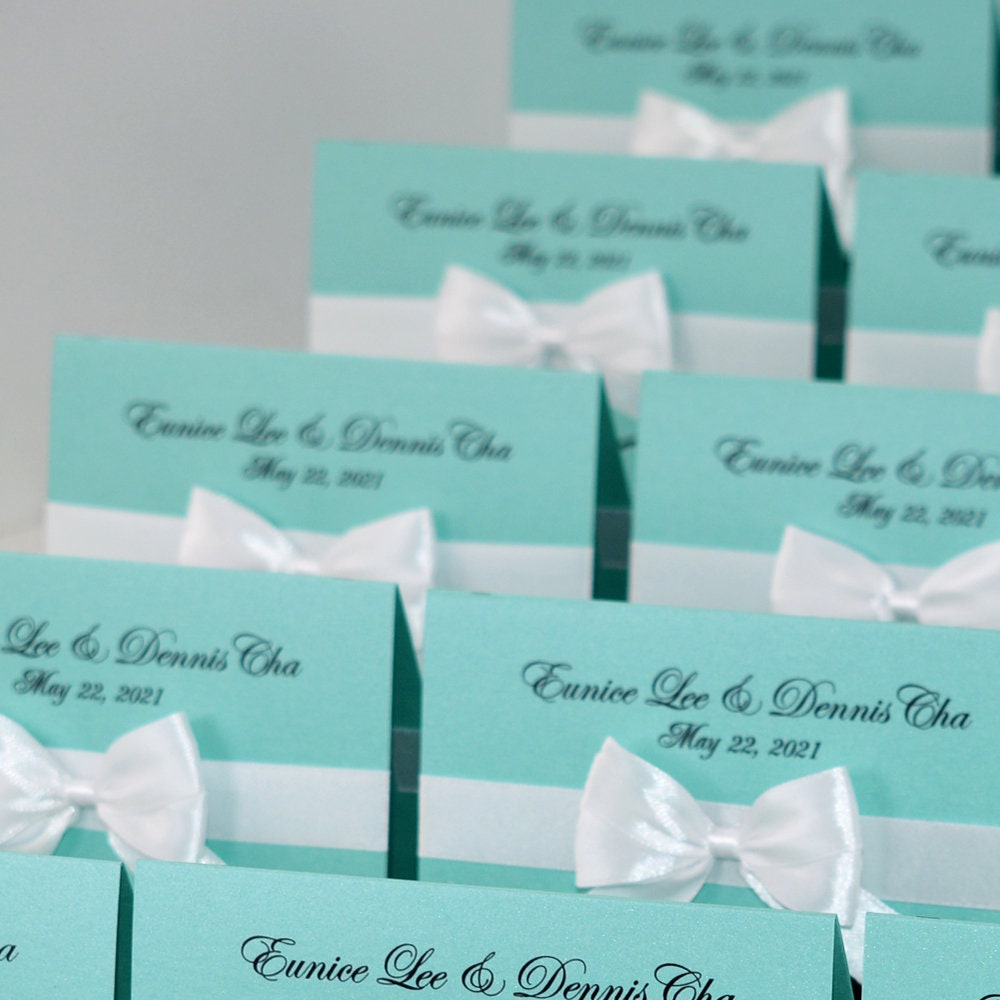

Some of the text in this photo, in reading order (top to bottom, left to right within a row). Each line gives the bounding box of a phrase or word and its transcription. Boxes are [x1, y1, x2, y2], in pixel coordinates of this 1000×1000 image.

[127, 401, 513, 462] Eunice Lee & Dennis Cha
[242, 454, 297, 490] May
[337, 469, 385, 489] 2021
[714, 434, 819, 476] Eunice
[828, 441, 886, 484] Lee
[896, 448, 934, 487] &
[836, 492, 895, 529] May
[938, 506, 988, 528] 2021
[1, 618, 300, 677] Lee & Dennis Cha
[13, 669, 164, 705] May 22, 2021
[522, 661, 971, 730] Eunice Lee & Dennis Cha
[658, 722, 821, 760] May 22, 2021
[241, 935, 369, 983] Eunice
[376, 943, 448, 990] Lee
[461, 952, 506, 997] &
